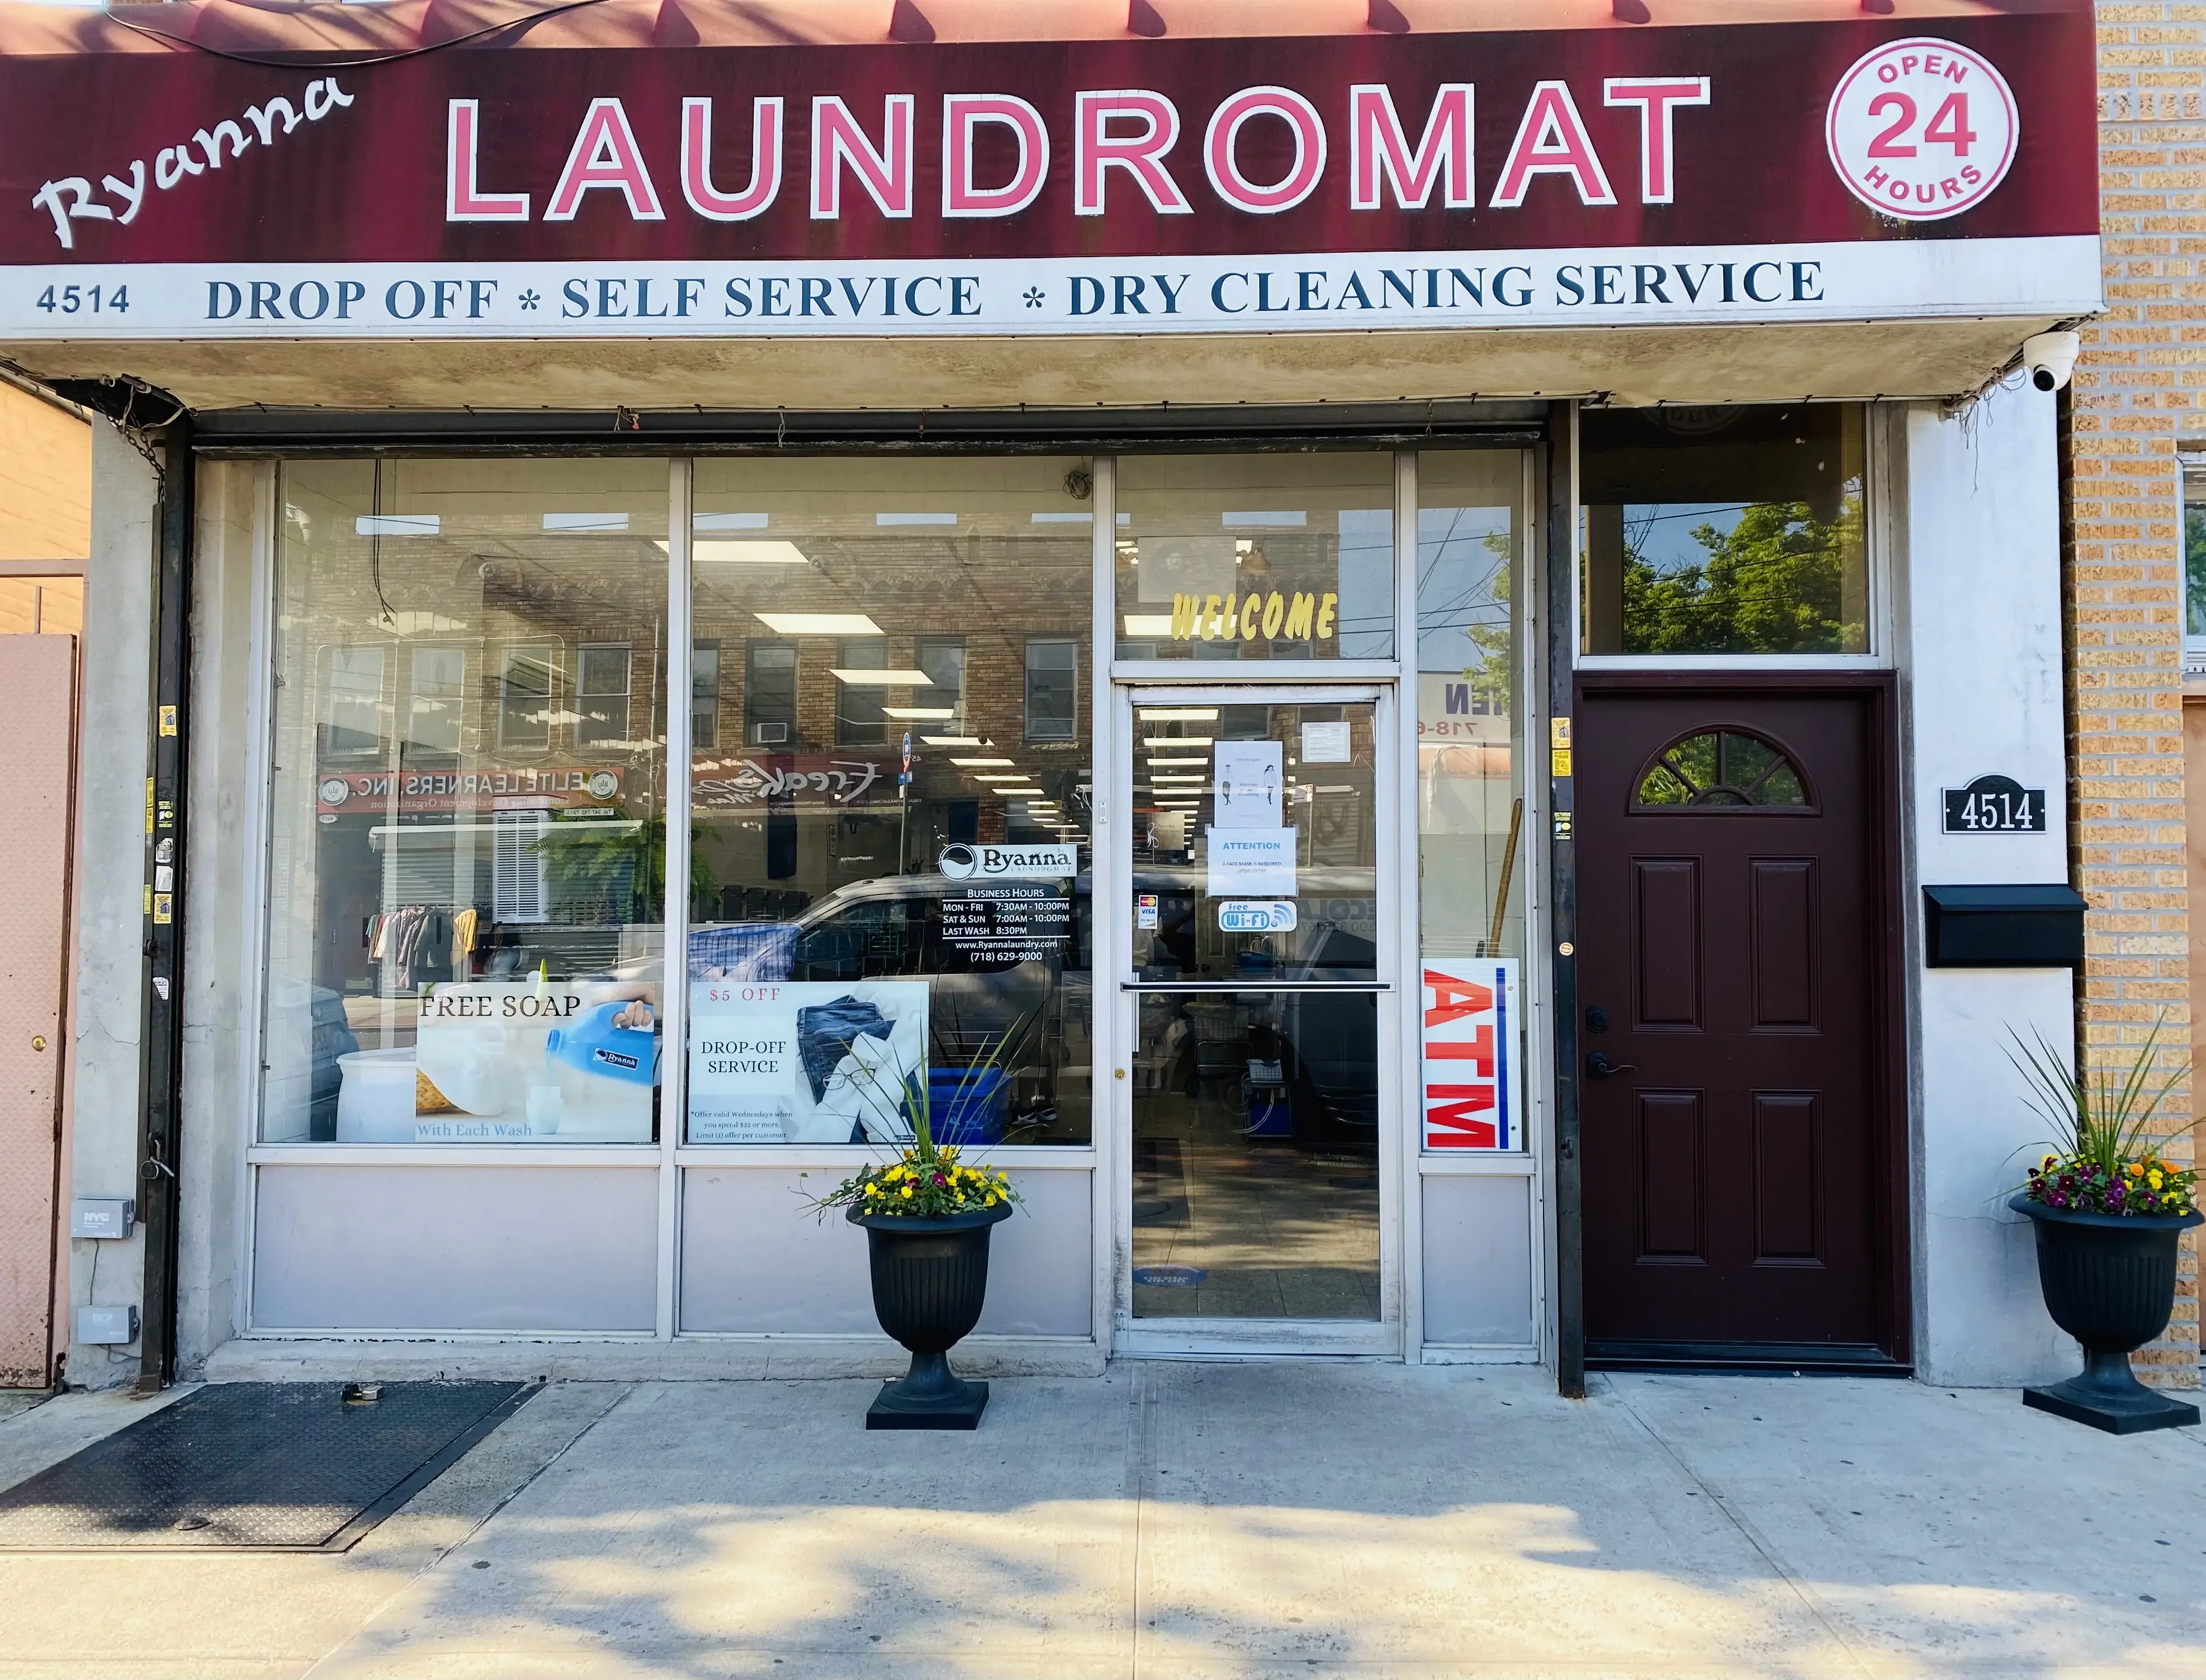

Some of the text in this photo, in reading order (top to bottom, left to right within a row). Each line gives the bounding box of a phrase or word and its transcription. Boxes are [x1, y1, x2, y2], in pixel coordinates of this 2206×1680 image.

[1878, 54, 1969, 84] OPEN
[1868, 92, 1977, 158] 24
[446, 77, 1711, 221] LAUNDROMAT
[32, 77, 354, 249] Ryanna
[1864, 164, 1982, 203] HOURS
[36, 285, 130, 314] 4514
[205, 280, 498, 319] DROP OFF
[562, 276, 982, 318] SELF SERVICE
[1067, 261, 1824, 315] DRY CLEANING SERVICE
[1171, 590, 1338, 641] WELCOME
[1961, 793, 2033, 829] 4514
[982, 849, 1071, 873] Ryanna
[967, 888, 1044, 898] BUSINESS HOURS
[943, 903, 963, 912] MON
[971, 903, 983, 911] FRI
[996, 902, 1028, 911] 7:30AM
[1034, 902, 1069, 910] 10:00PM
[943, 915, 959, 924] SAT
[969, 915, 986, 923] SUN
[996, 914, 1028, 922] 7:00AM
[1034, 914, 1069, 922] 10:00PM
[955, 940, 1058, 950] www.Ryannalaundry.com
[971, 952, 1042, 962] (718) 629-9000
[420, 995, 581, 1017] FREE SOAP
[709, 987, 780, 1002] $5 OFF
[608, 1053, 636, 1066] Ryanna
[701, 1041, 787, 1054] DROP-OFF
[1424, 968, 1496, 1147] ATM
[708, 1060, 779, 1073] SERVICE
[418, 1122, 532, 1137] With Each Wash
[84, 1213, 110, 1222] NYC
